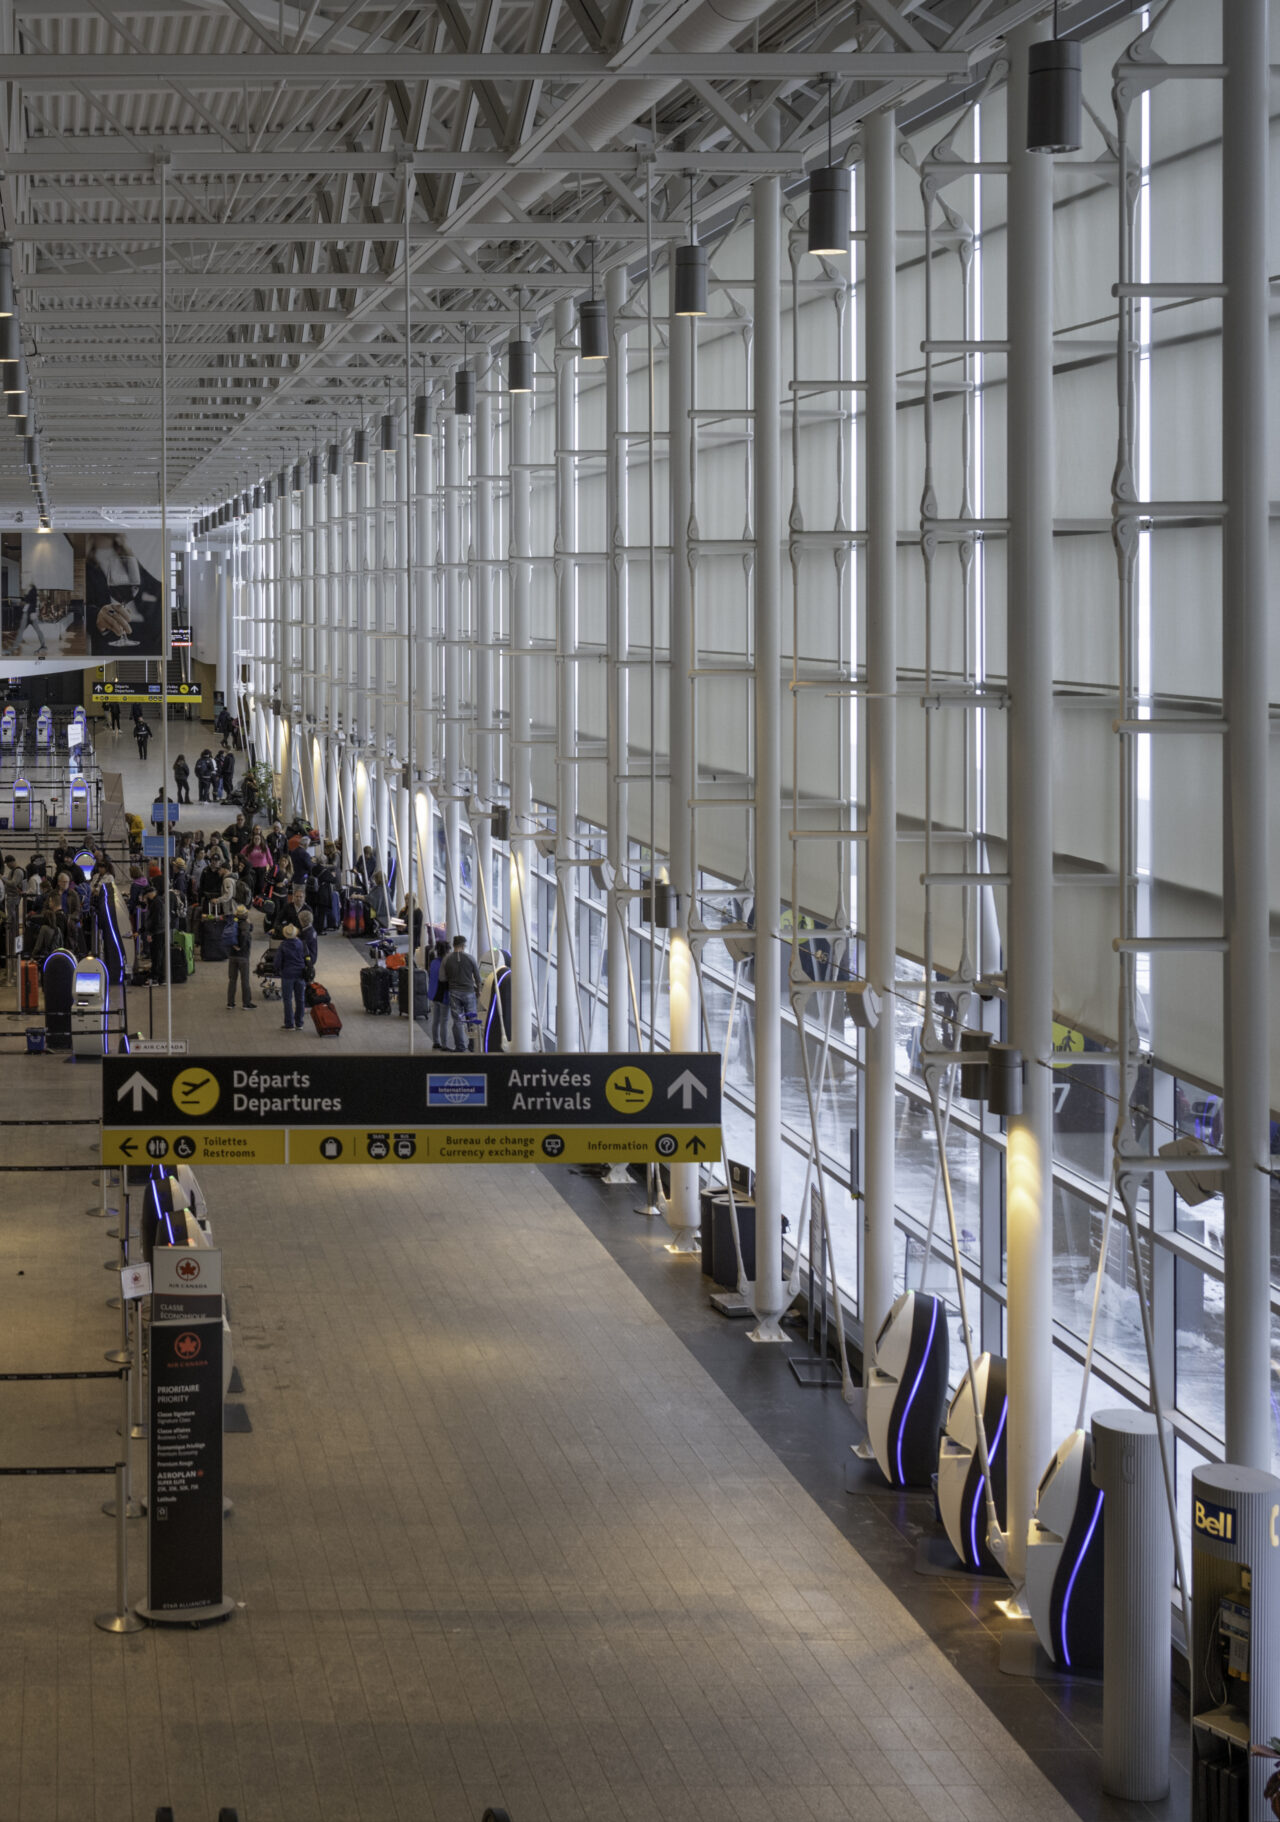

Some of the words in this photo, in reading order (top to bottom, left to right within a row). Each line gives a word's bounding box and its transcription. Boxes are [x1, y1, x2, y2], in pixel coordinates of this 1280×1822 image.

[232, 1069, 311, 1094] Départs
[507, 1068, 592, 1088] Arrivées
[438, 1086, 476, 1094] International
[232, 1094, 342, 1117] Departures
[511, 1092, 592, 1111] Arrivals
[203, 1137, 248, 1147] Toilettes
[446, 1136, 481, 1146] Bureau
[484, 1136, 495, 1146] de
[499, 1136, 536, 1148] change
[587, 1140, 648, 1151] Information
[203, 1148, 256, 1158] Restrooms
[439, 1148, 485, 1158] Currency
[488, 1148, 536, 1159] exchange
[160, 1304, 184, 1312] CLASSE
[167, 1361, 178, 1369] AIR
[180, 1359, 208, 1368] CANADA
[157, 1384, 200, 1394] PRIORITAIRE
[157, 1394, 190, 1404] PRIORITY
[1194, 1500, 1233, 1541] Bell
